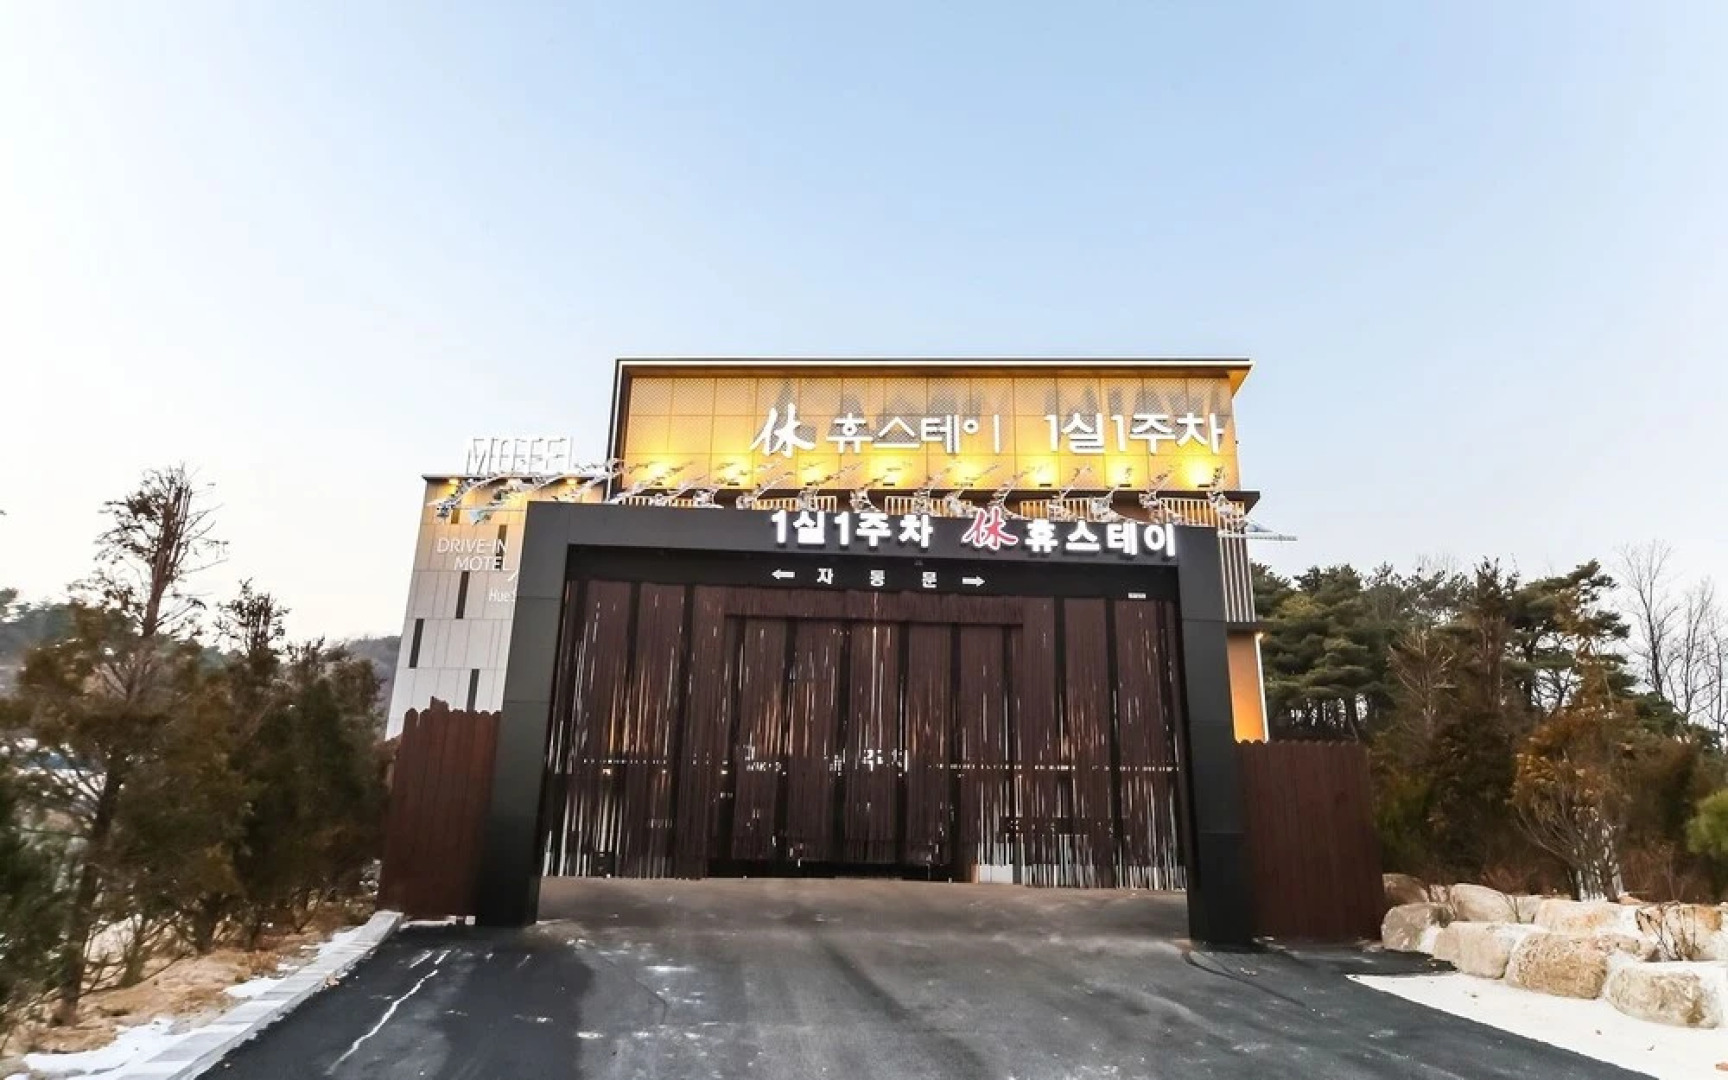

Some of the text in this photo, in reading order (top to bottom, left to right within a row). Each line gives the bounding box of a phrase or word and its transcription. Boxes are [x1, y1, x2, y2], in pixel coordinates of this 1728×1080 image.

[749, 402, 1224, 458] 休 휴스테이 1실1주차
[436, 537, 509, 554] DRIVE-IN
[771, 506, 1176, 557] 1실1주차 休 휴스테이
[453, 556, 513, 571] MOTEL
